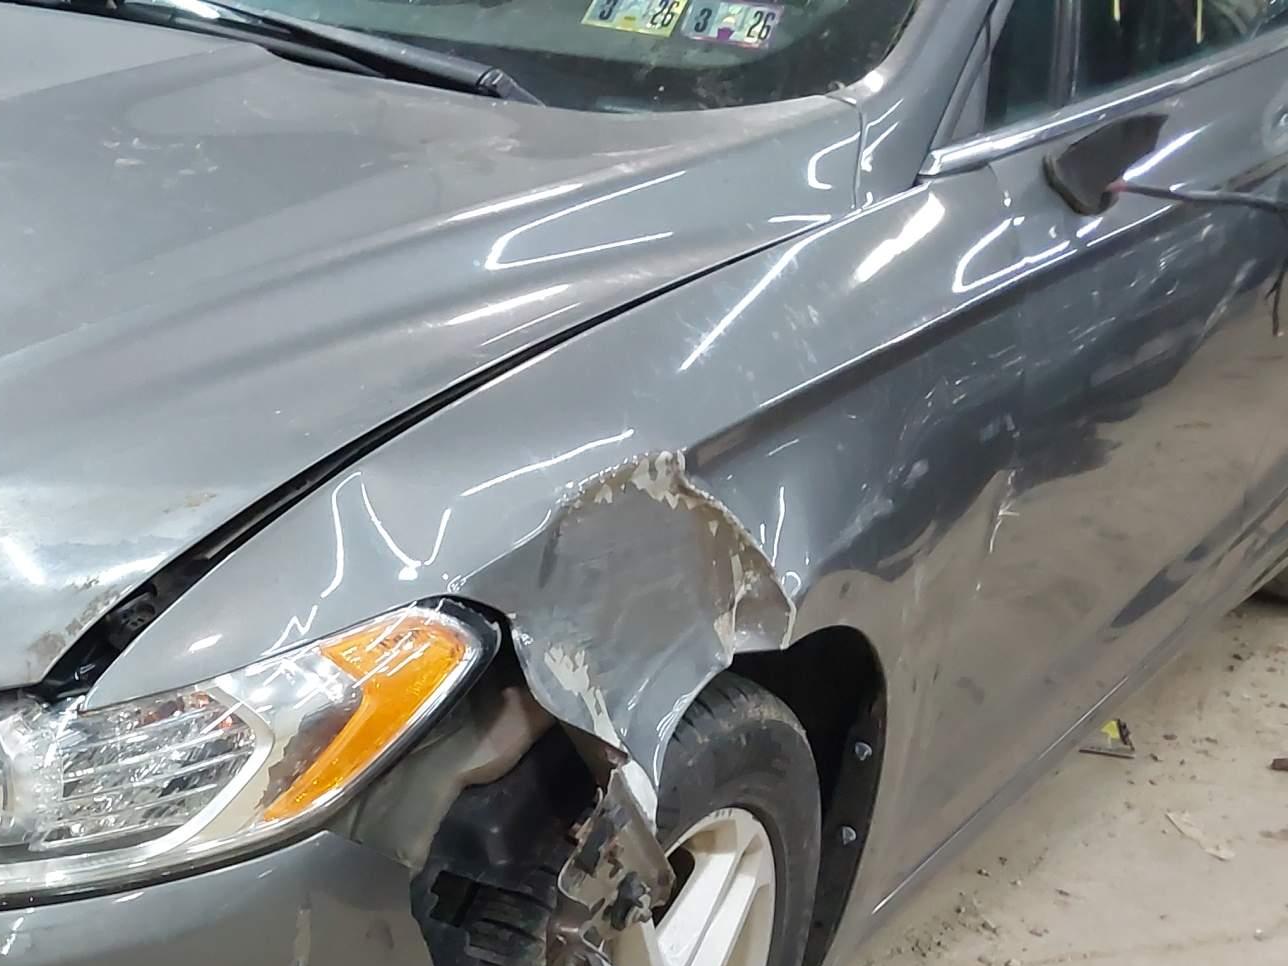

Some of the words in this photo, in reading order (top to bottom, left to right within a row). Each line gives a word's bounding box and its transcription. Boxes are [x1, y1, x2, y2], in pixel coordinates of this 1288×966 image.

[599, 0, 618, 20] 3
[650, 0, 680, 28] 26
[694, 8, 712, 33] 3
[746, 10, 776, 40] 26
